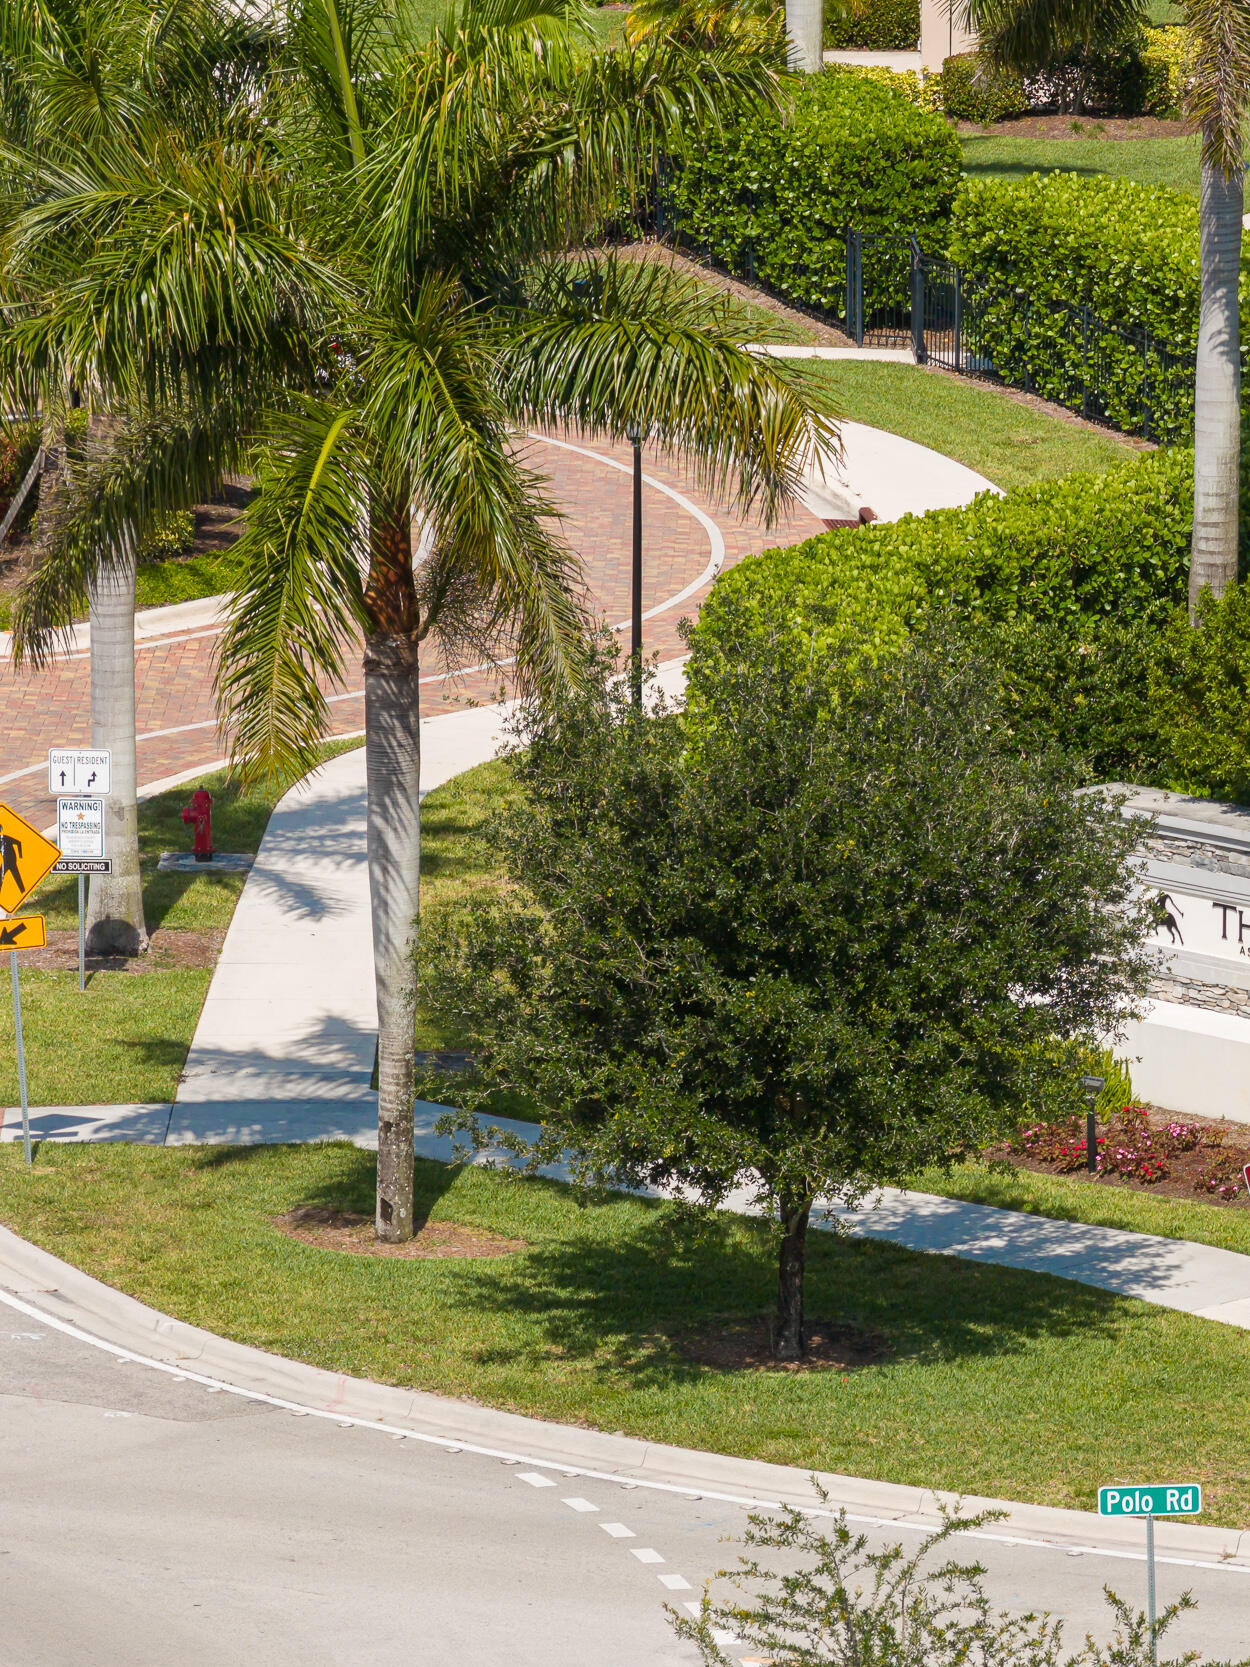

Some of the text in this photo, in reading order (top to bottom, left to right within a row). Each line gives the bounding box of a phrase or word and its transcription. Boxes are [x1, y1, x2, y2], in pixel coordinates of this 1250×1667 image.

[53, 756, 73, 764] GUEST
[77, 756, 108, 765] RESIDENT
[61, 801, 101, 811] WARNING!
[56, 862, 106, 871] NO SOLICITING
[1239, 946, 1246, 956] A
[1107, 1489, 1193, 1512] Polo Rd
